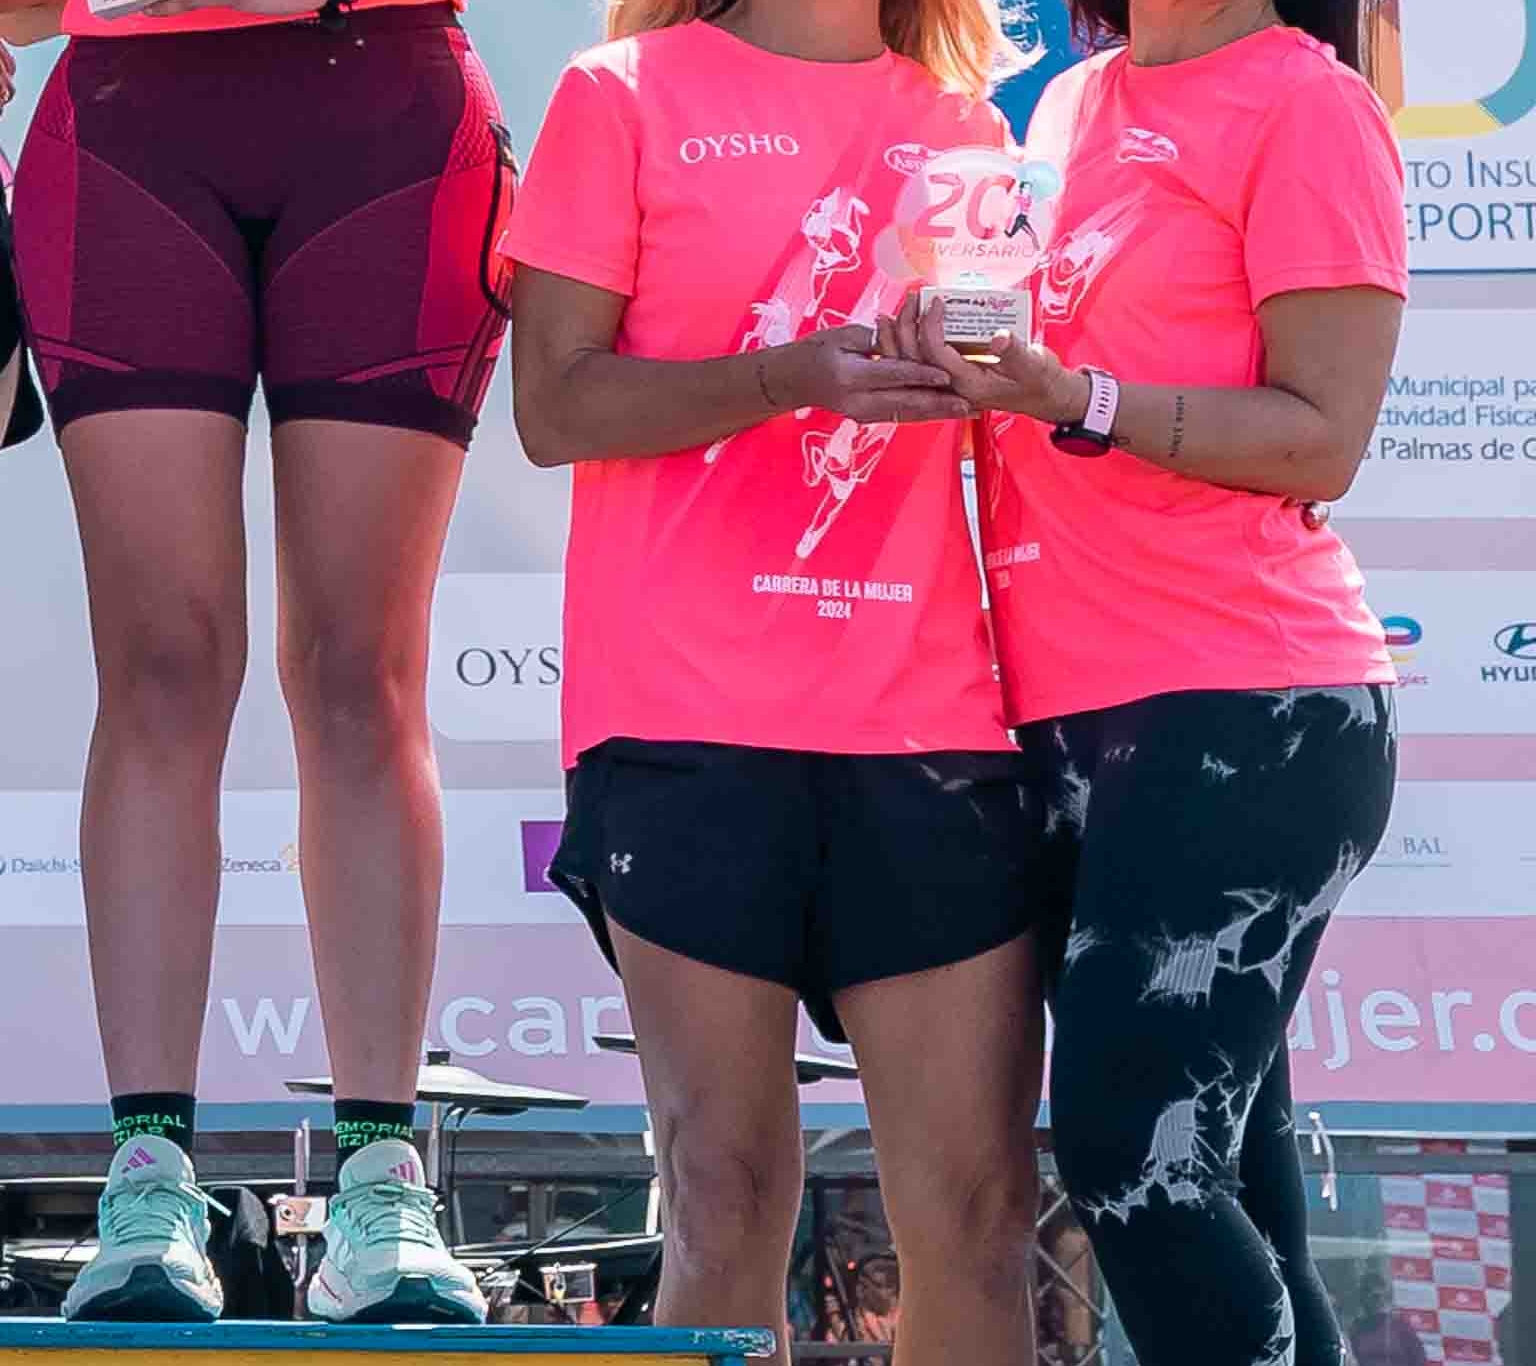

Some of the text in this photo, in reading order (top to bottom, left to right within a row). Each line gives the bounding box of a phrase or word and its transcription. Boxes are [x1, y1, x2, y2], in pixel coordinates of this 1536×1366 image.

[679, 133, 800, 164] OYSHO
[1387, 375, 1505, 401] Municipal
[1376, 404, 1466, 428] ctividad
[1381, 437, 1473, 461] Palmas
[1480, 437, 1515, 461] de
[752, 575, 913, 602] CARRERA DE LA MUJER
[817, 600, 852, 619] 2024
[456, 647, 561, 687] OYS
[221, 858, 280, 874] Zeneca
